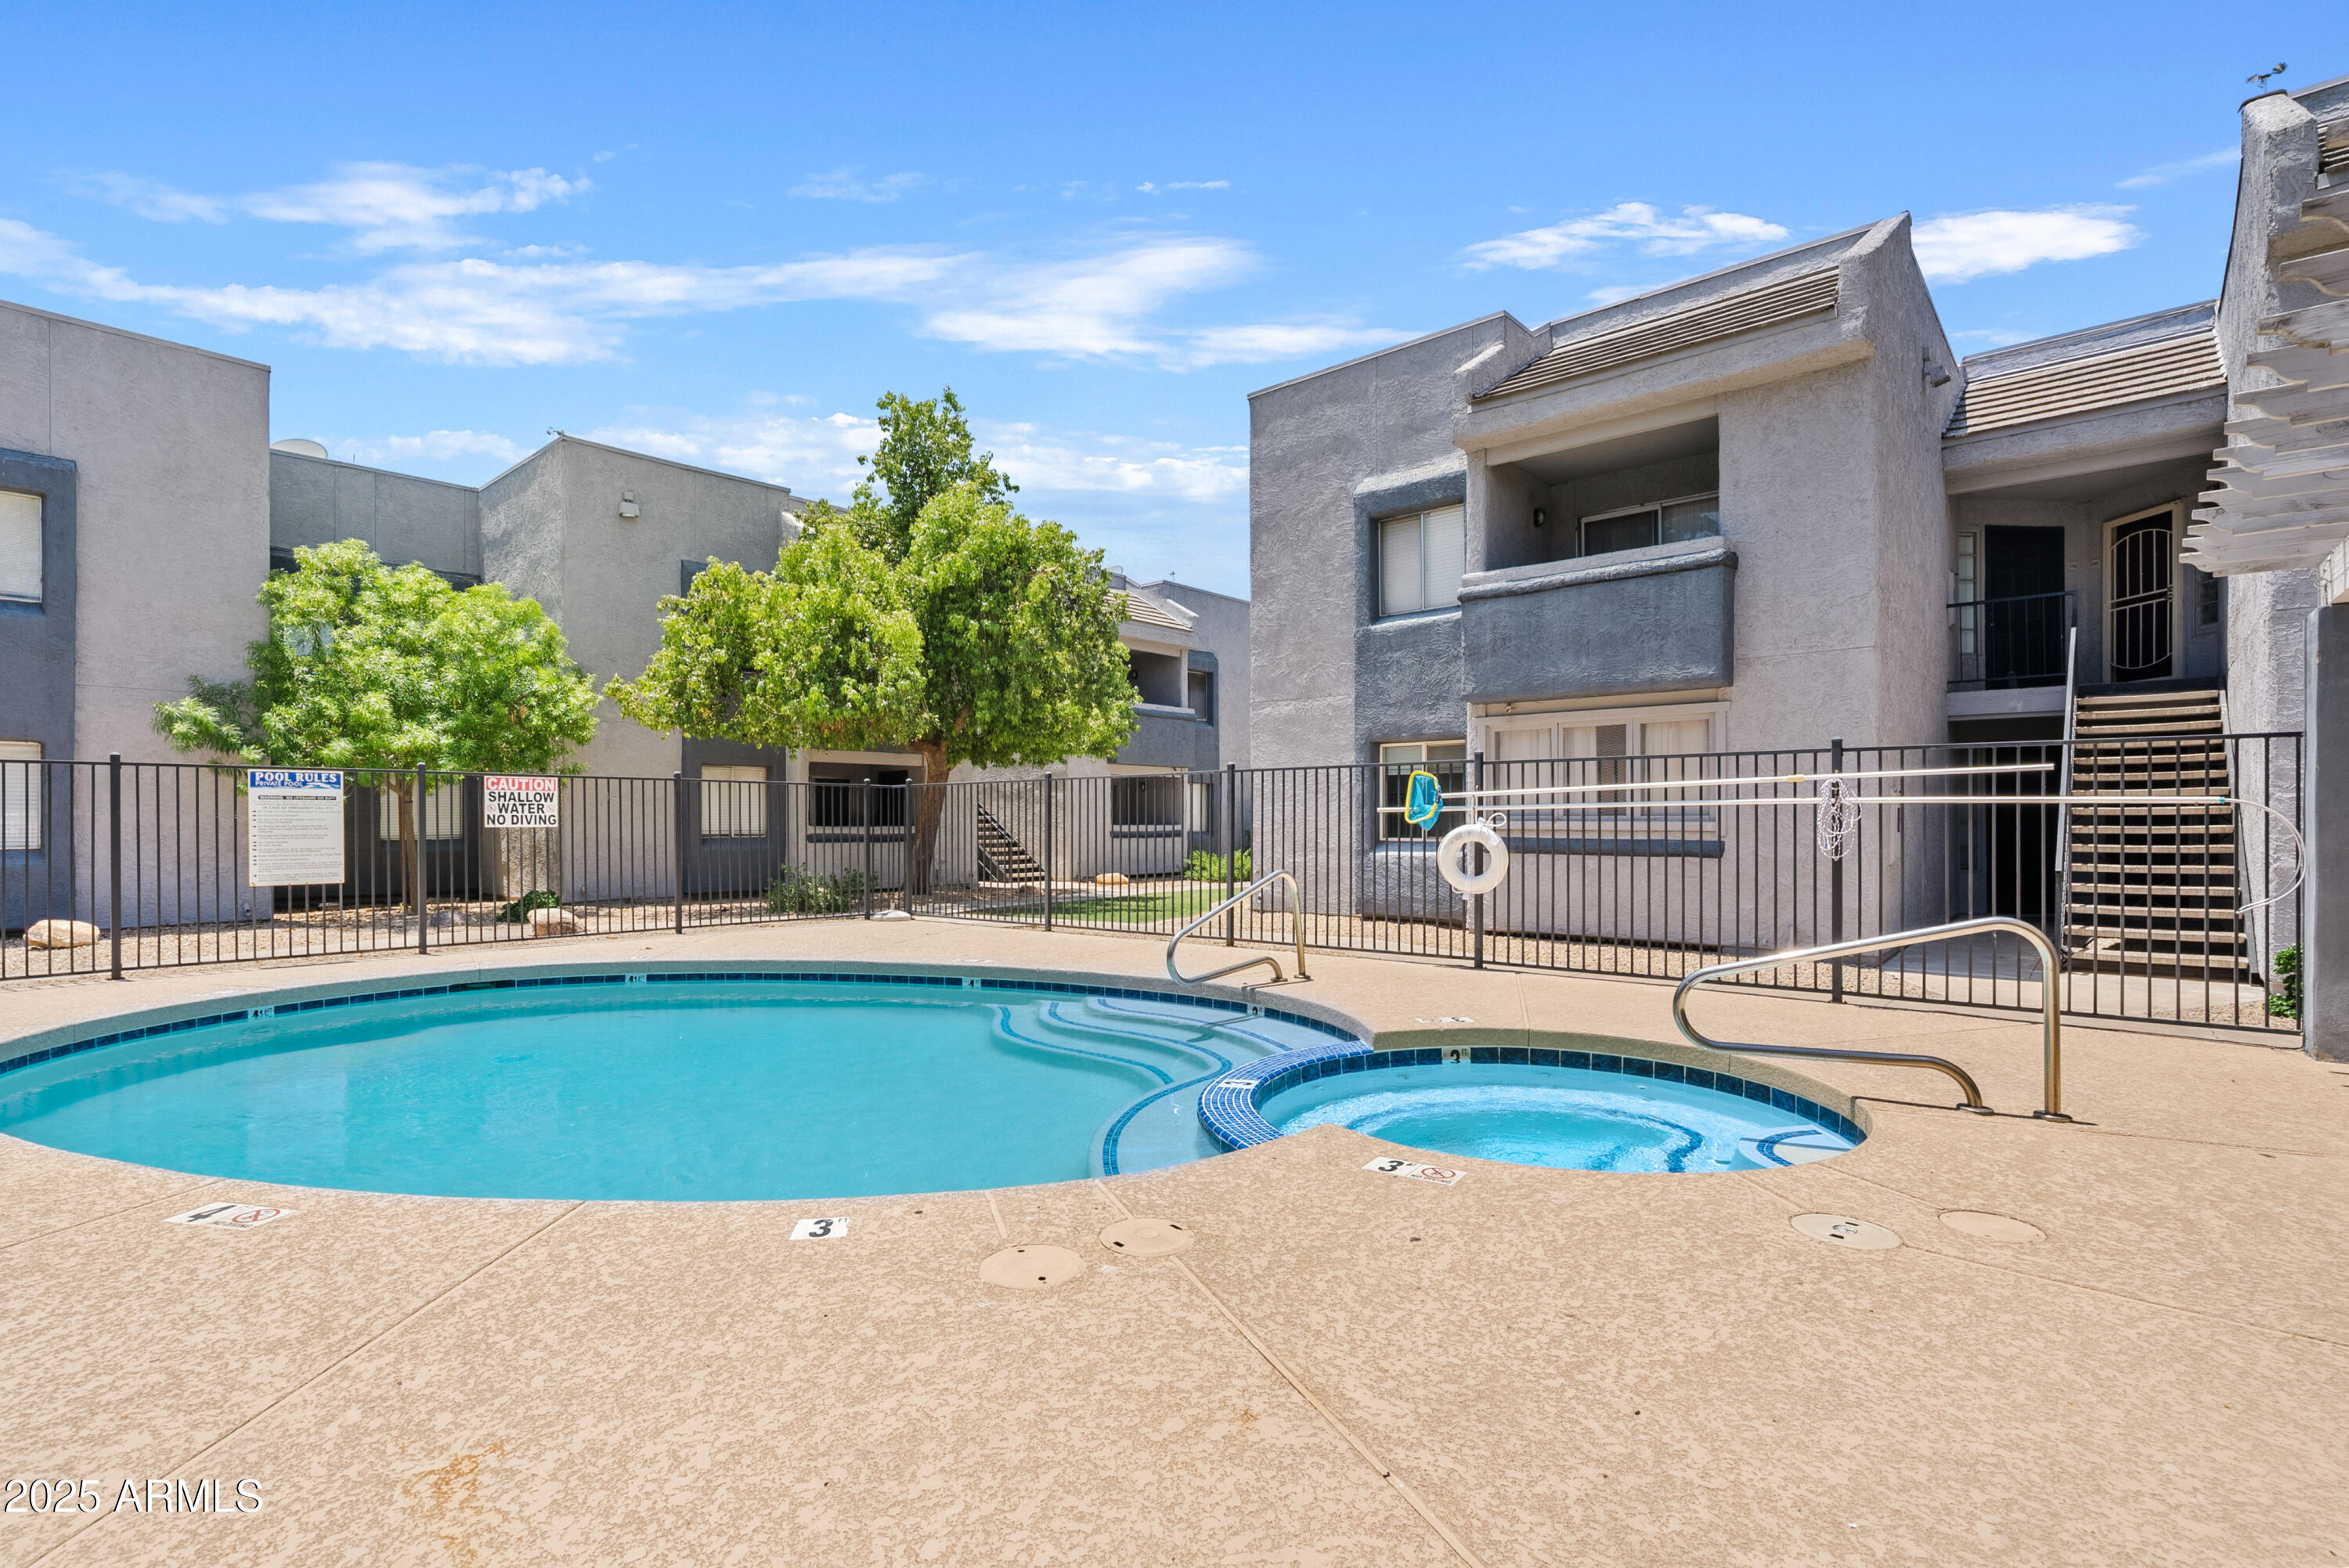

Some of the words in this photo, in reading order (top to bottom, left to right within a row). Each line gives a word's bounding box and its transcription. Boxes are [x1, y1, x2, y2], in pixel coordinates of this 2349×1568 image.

[255, 772, 291, 781] POOL
[296, 773, 337, 783] RULES
[487, 777, 555, 791] CAUTION
[489, 791, 554, 802] SHALLOW
[498, 803, 545, 814] WATER
[487, 814, 506, 825] NO
[511, 815, 556, 825] DIVING
[1377, 1160, 1404, 1172] 3
[1423, 1176, 1452, 1184] DIVING
[186, 1205, 238, 1223] 4
[809, 1219, 833, 1237] 3
